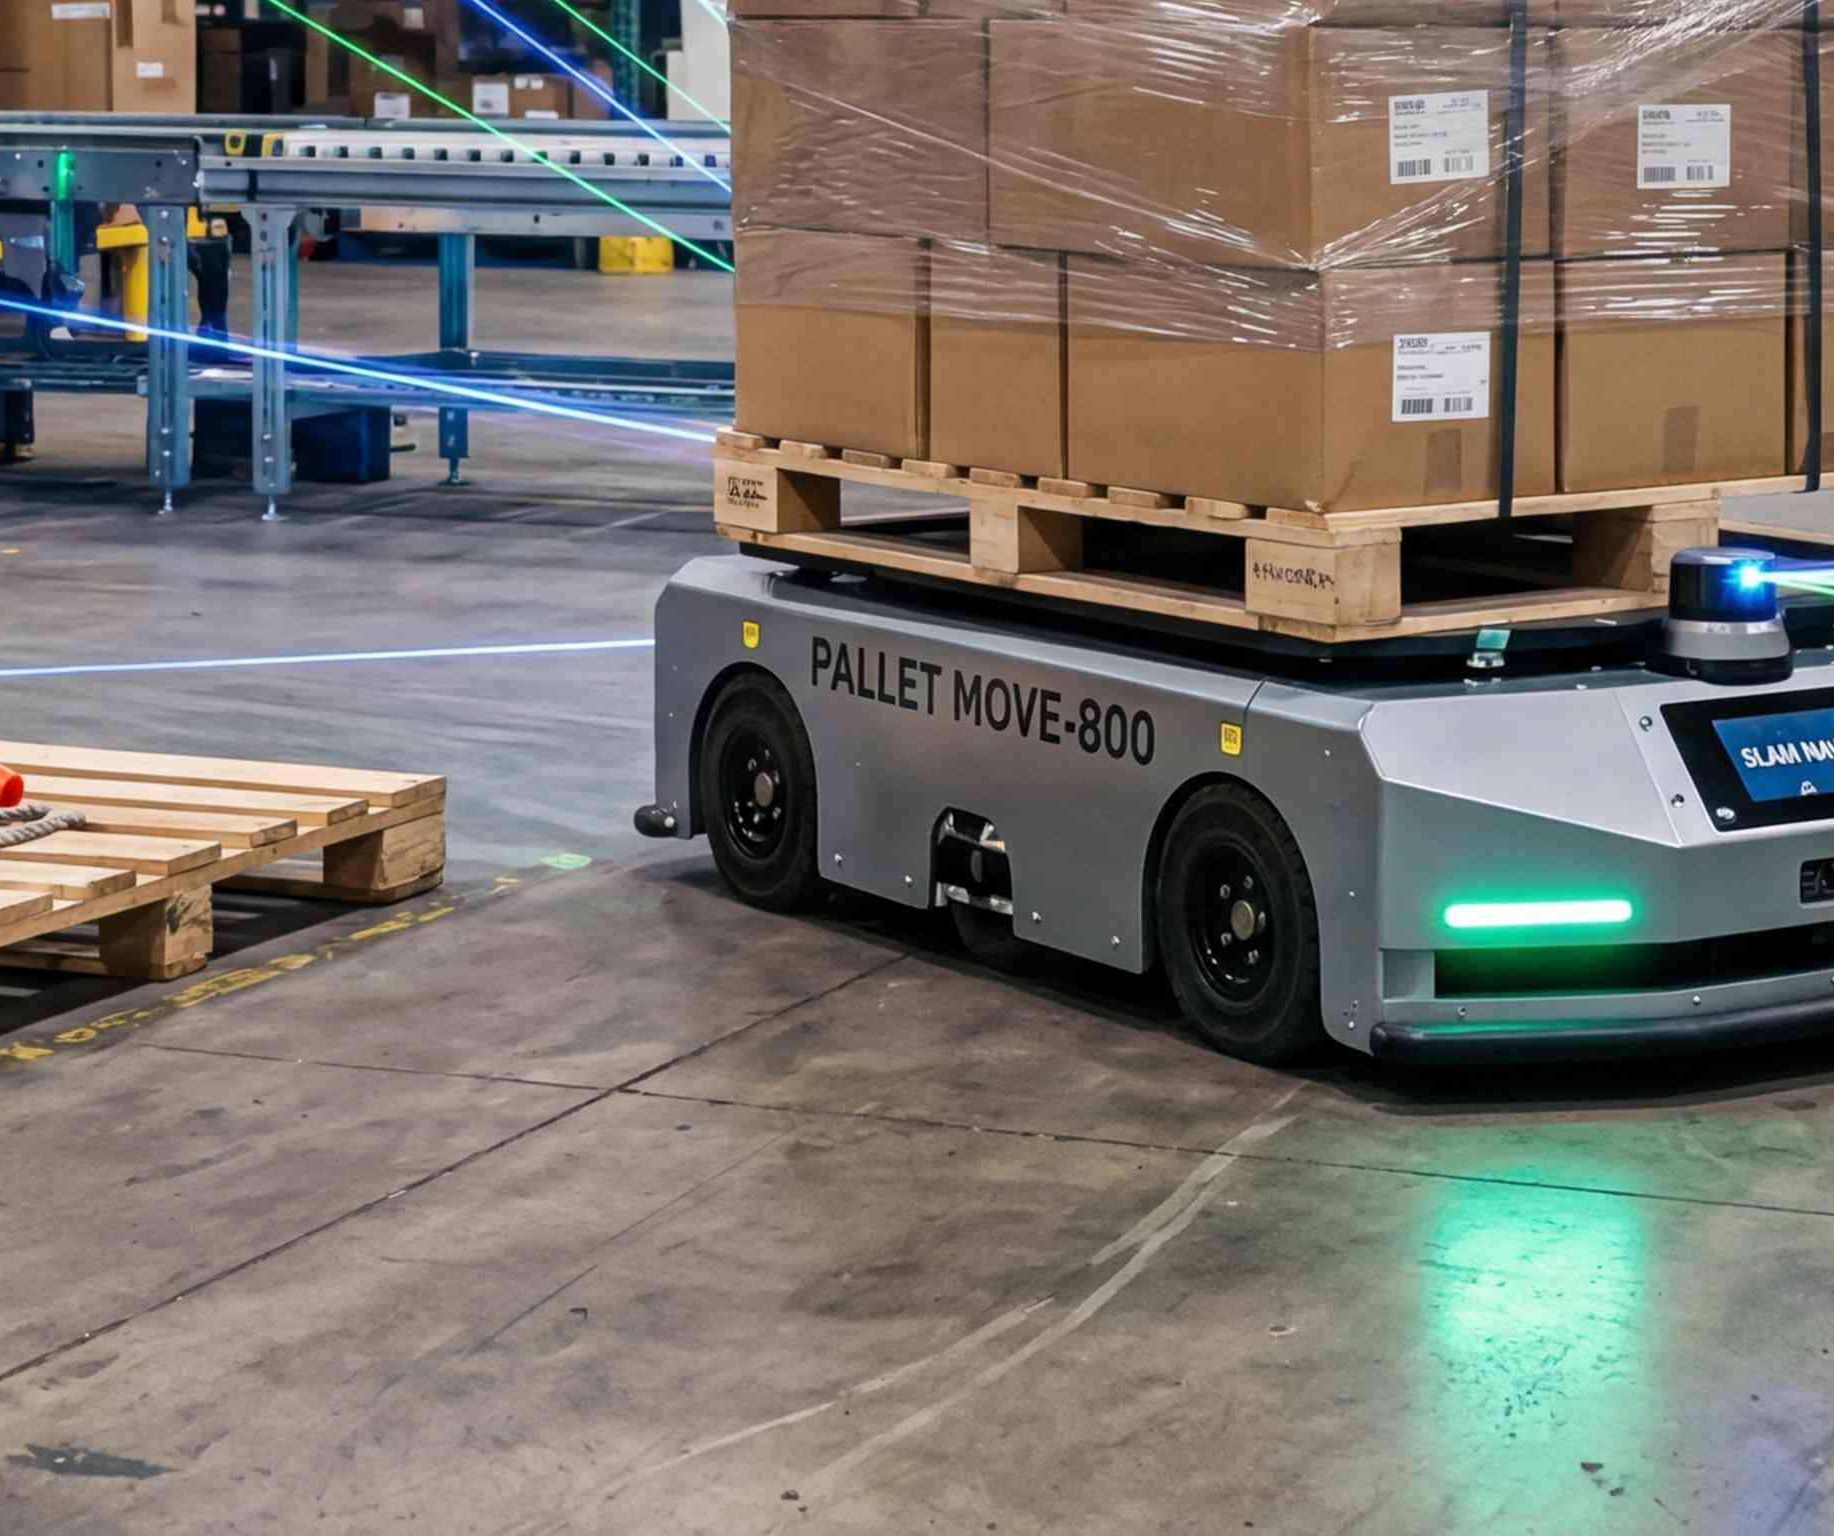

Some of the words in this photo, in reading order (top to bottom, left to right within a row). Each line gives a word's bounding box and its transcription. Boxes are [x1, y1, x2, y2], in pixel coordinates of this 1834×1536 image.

[811, 636, 943, 715] PALLET
[954, 669, 1155, 766] MOVE-800
[1740, 743, 1802, 768] SLAM
